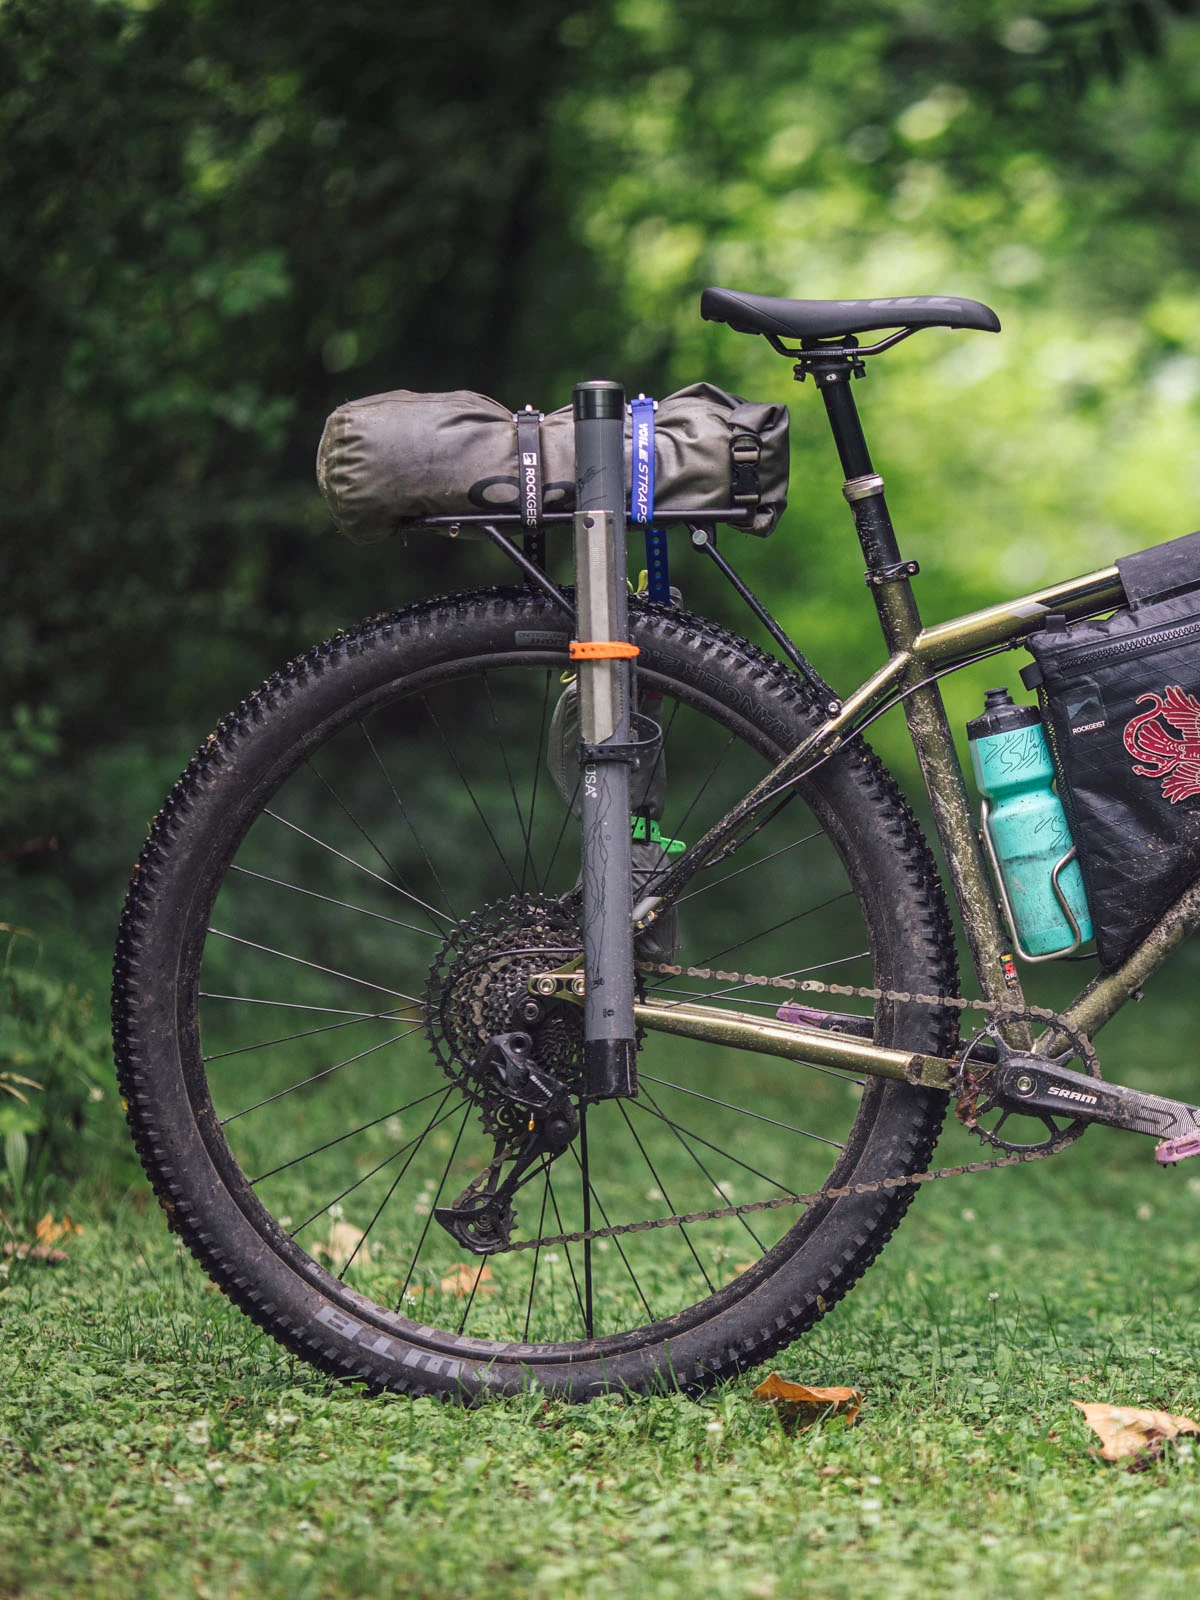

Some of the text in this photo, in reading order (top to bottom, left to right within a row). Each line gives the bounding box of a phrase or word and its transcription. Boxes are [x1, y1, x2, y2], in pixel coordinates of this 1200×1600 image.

[637, 462, 649, 525] STRAPS
[685, 661, 798, 746] RANGER
[1072, 720, 1106, 735] ROCKGEIST
[1047, 1086, 1098, 1105] SRAM
[313, 1305, 466, 1379] WTB
